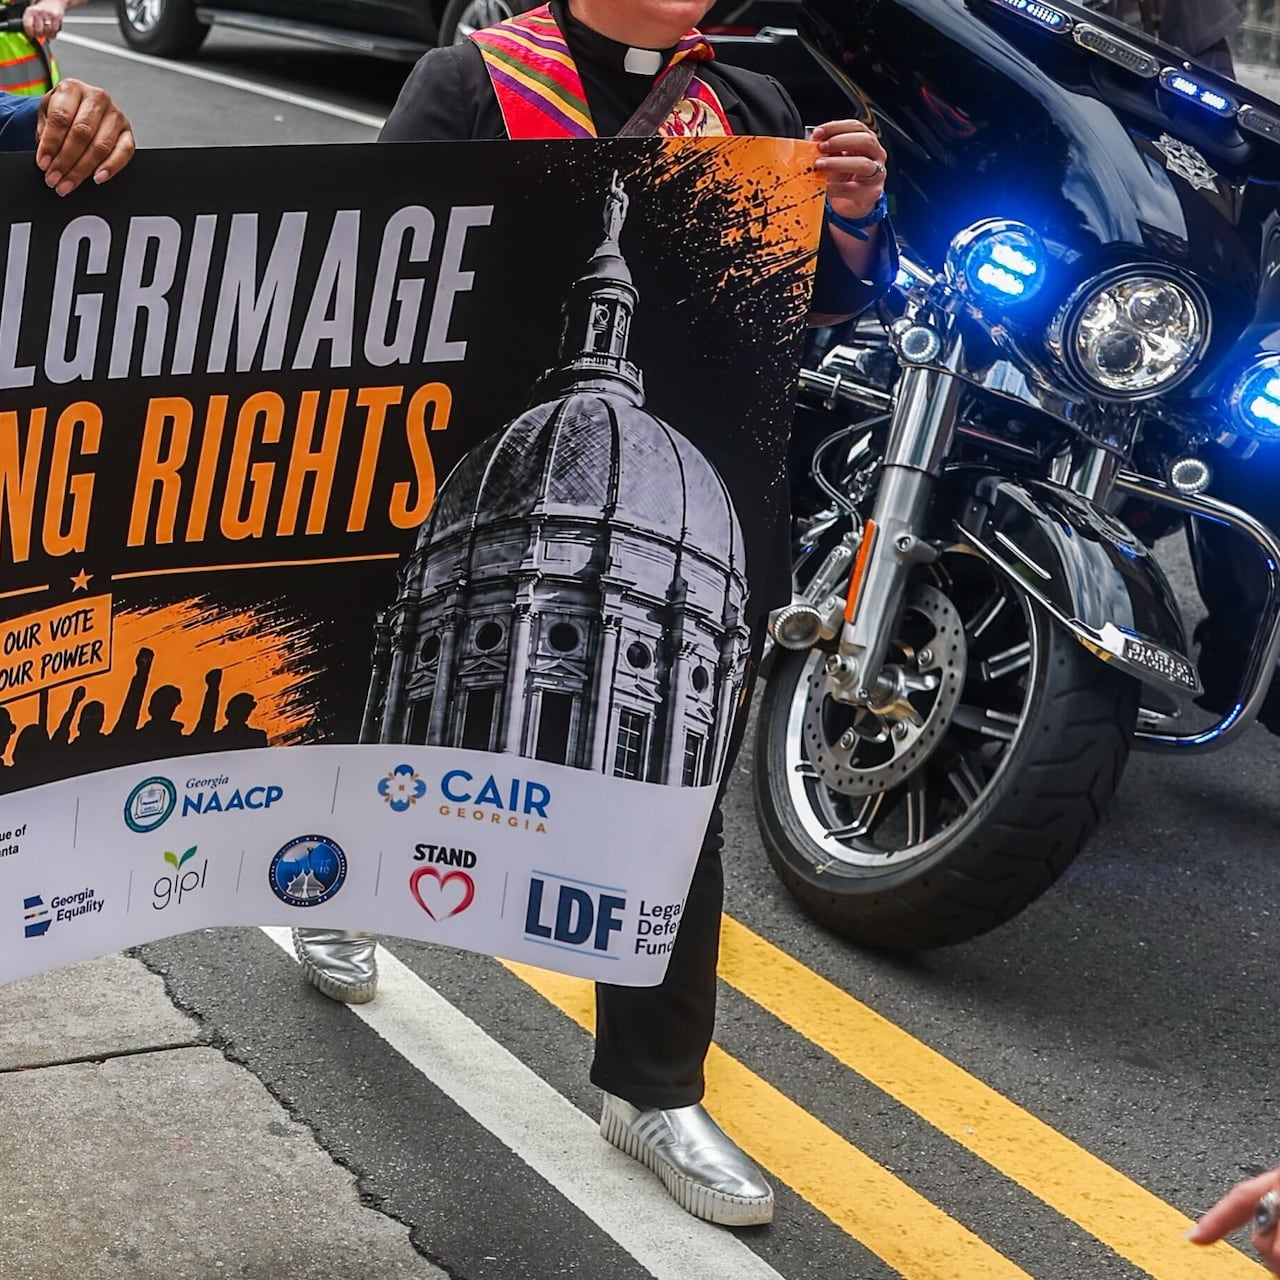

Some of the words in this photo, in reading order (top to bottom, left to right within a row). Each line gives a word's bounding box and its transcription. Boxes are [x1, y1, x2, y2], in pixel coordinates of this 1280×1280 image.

[126, 382, 453, 548] RIGHTS
[3, 623, 41, 656] OUR
[49, 608, 95, 641] VOTE
[40, 639, 103, 680] POWER
[186, 774, 229, 790] Georgia
[440, 769, 551, 818] CAIR
[181, 785, 283, 817] NAACP
[14, 824, 28, 837] of
[439, 805, 547, 834] GEORGIA
[413, 843, 477, 869] STAND
[50, 887, 95, 909] Georgia
[152, 859, 208, 910] gipl
[57, 898, 105, 923] Equality
[524, 877, 627, 951] LDF
[637, 919, 679, 937] Defe
